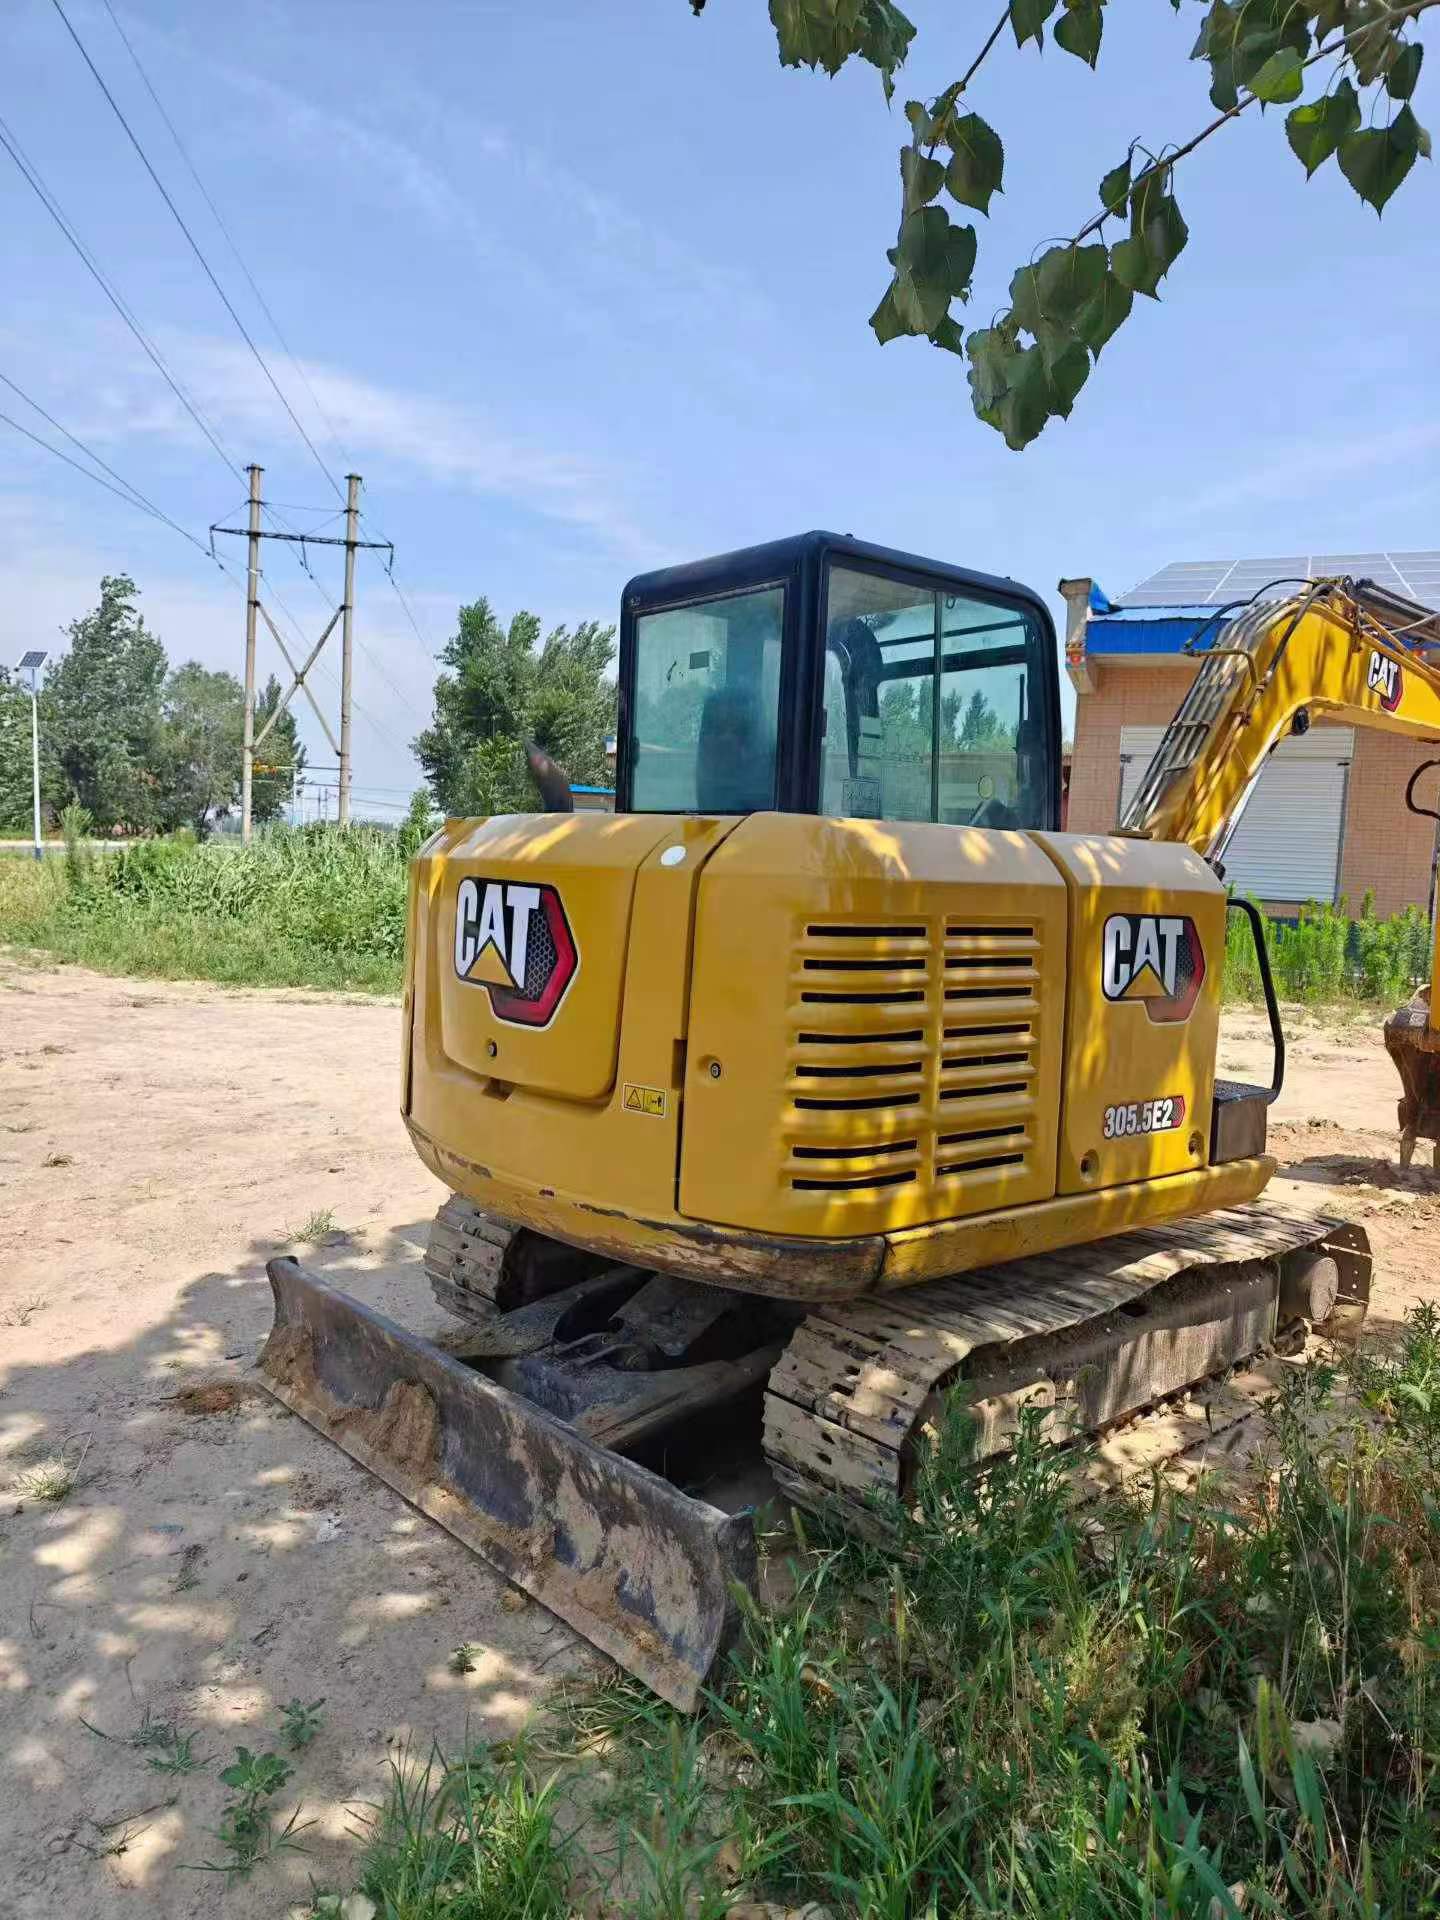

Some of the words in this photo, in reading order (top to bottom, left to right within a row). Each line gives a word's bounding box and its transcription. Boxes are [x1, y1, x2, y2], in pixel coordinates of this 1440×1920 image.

[1368, 651, 1398, 698] CAT
[456, 879, 540, 989] CAT
[1104, 916, 1183, 997] CAT
[1104, 1098, 1174, 1138] 305.5E2
